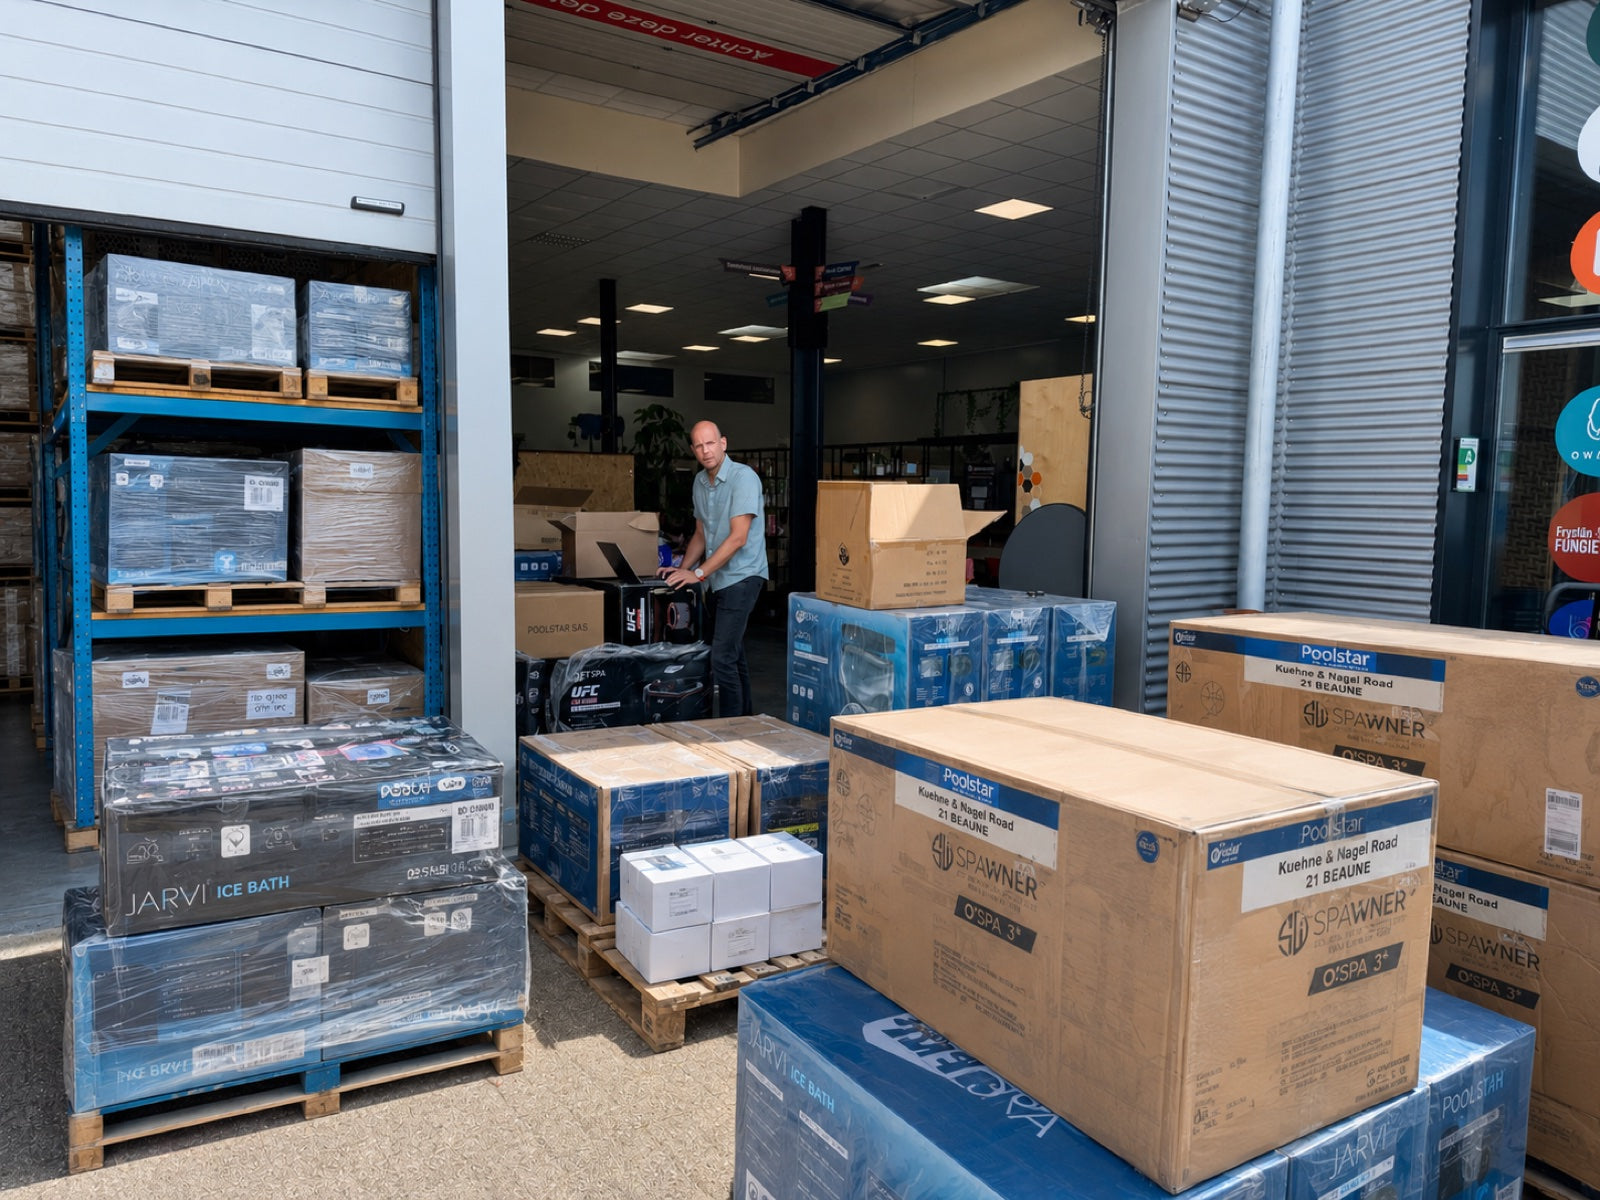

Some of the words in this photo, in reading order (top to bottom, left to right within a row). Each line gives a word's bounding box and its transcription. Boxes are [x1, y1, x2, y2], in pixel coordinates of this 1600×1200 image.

[551, 0, 601, 13] de
[607, 11, 677, 34] deze
[680, 31, 774, 60] Achter
[527, 624, 569, 634] POOLSTAR
[571, 623, 588, 632] SAS
[1302, 645, 1370, 666] Poolstar
[1275, 664, 1314, 678] Kuehne
[1317, 670, 1325, 679] &
[1328, 672, 1360, 685] Nagel
[1363, 674, 1393, 688] Road
[1300, 679, 1311, 688] 21
[1316, 681, 1363, 696] BEAUNE
[571, 684, 600, 698] UFC
[1332, 707, 1425, 739] SPAWNER
[943, 768, 995, 798] Poolstar
[918, 786, 949, 807] Kuehne
[951, 798, 958, 810] &
[960, 802, 987, 820] Nagel
[989, 812, 1014, 831] Road
[938, 808, 948, 821] 21
[950, 813, 989, 837] BEAUNE
[1301, 816, 1364, 844] Poolstar
[1278, 854, 1322, 875] Kuehne
[1325, 850, 1334, 864] &
[1337, 842, 1368, 862] Nagel
[1371, 834, 1398, 853] Road
[956, 846, 1037, 901] SPAWNER
[1305, 873, 1319, 888] 21
[1323, 861, 1371, 884] BEAUNE
[126, 883, 206, 917] JARVI
[217, 878, 245, 899] ICE
[247, 875, 290, 895] BATH
[1468, 893, 1498, 909] Road
[1313, 889, 1406, 936] SPAWNER
[1445, 926, 1540, 972] SPAWNER
[790, 1065, 807, 1089] ICE
[808, 1080, 835, 1114] BATH
[1329, 1123, 1387, 1180] JARVI
